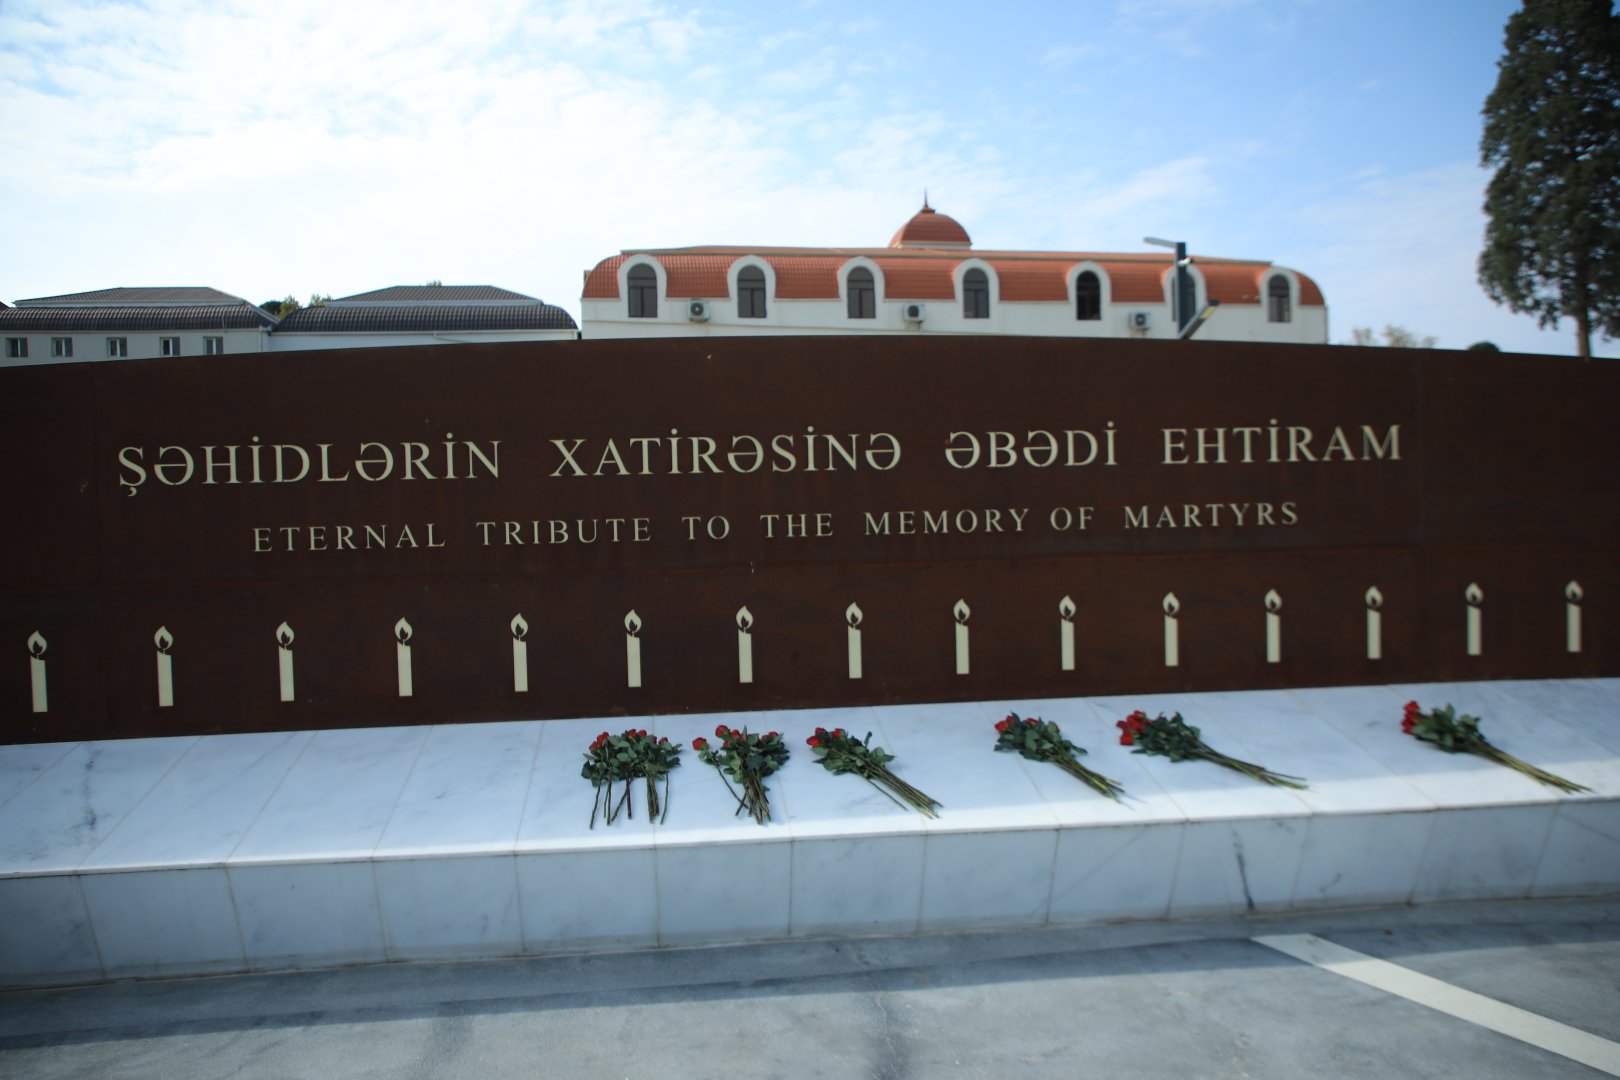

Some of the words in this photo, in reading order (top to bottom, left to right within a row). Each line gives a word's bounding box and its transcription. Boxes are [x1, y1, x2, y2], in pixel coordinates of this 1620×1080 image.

[118, 432, 501, 497] ŞƏHİDLƏRİN
[549, 426, 902, 477] XATİRƏSİNƏ
[944, 421, 1117, 469] ƏBƏDİ
[1162, 418, 1401, 465] EHTİRAM
[253, 523, 446, 552] ETERNAL
[475, 517, 651, 546] TRIBUTE
[681, 516, 731, 541] TO
[760, 513, 833, 538] THE
[863, 508, 1029, 536] MEMORY
[1049, 506, 1094, 531] OF
[1123, 502, 1298, 529] MARTYRS
